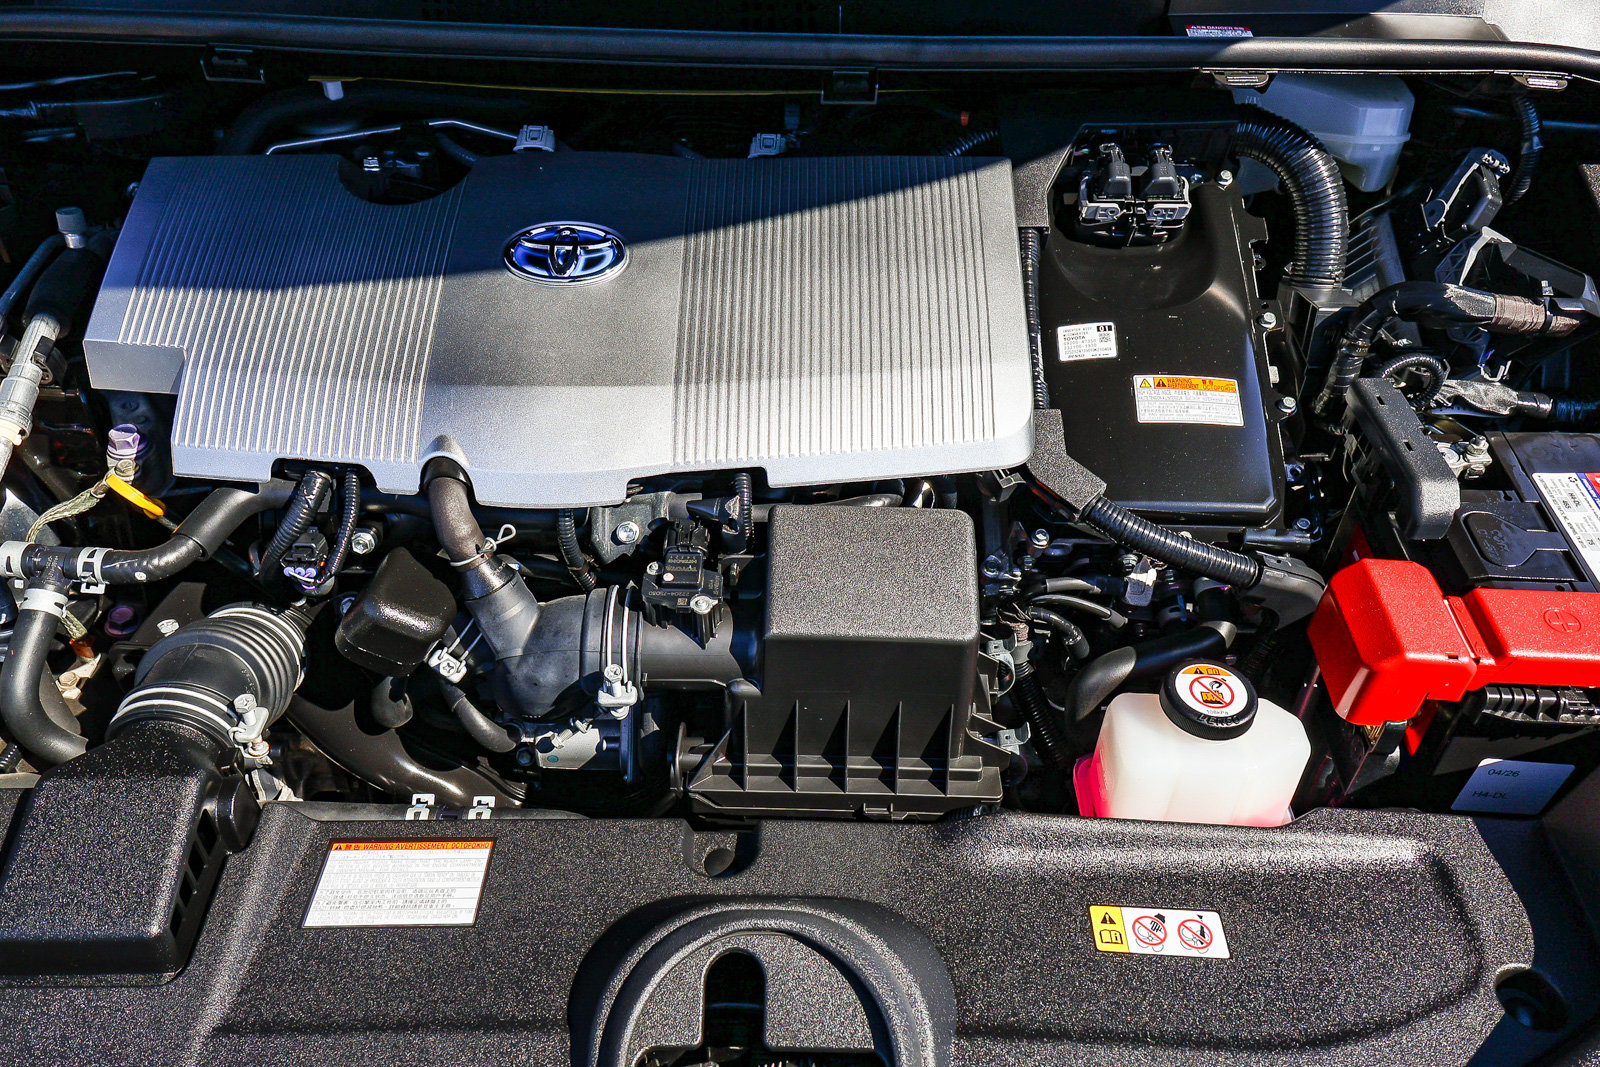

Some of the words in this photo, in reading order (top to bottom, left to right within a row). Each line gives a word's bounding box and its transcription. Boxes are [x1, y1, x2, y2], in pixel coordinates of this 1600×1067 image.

[1197, 713, 1240, 726] DENSO
[1487, 768, 1520, 778] 04/26
[1472, 791, 1509, 799] H4-DL
[363, 842, 394, 850] WARNING
[395, 842, 450, 850] AVERTISSEMENT
